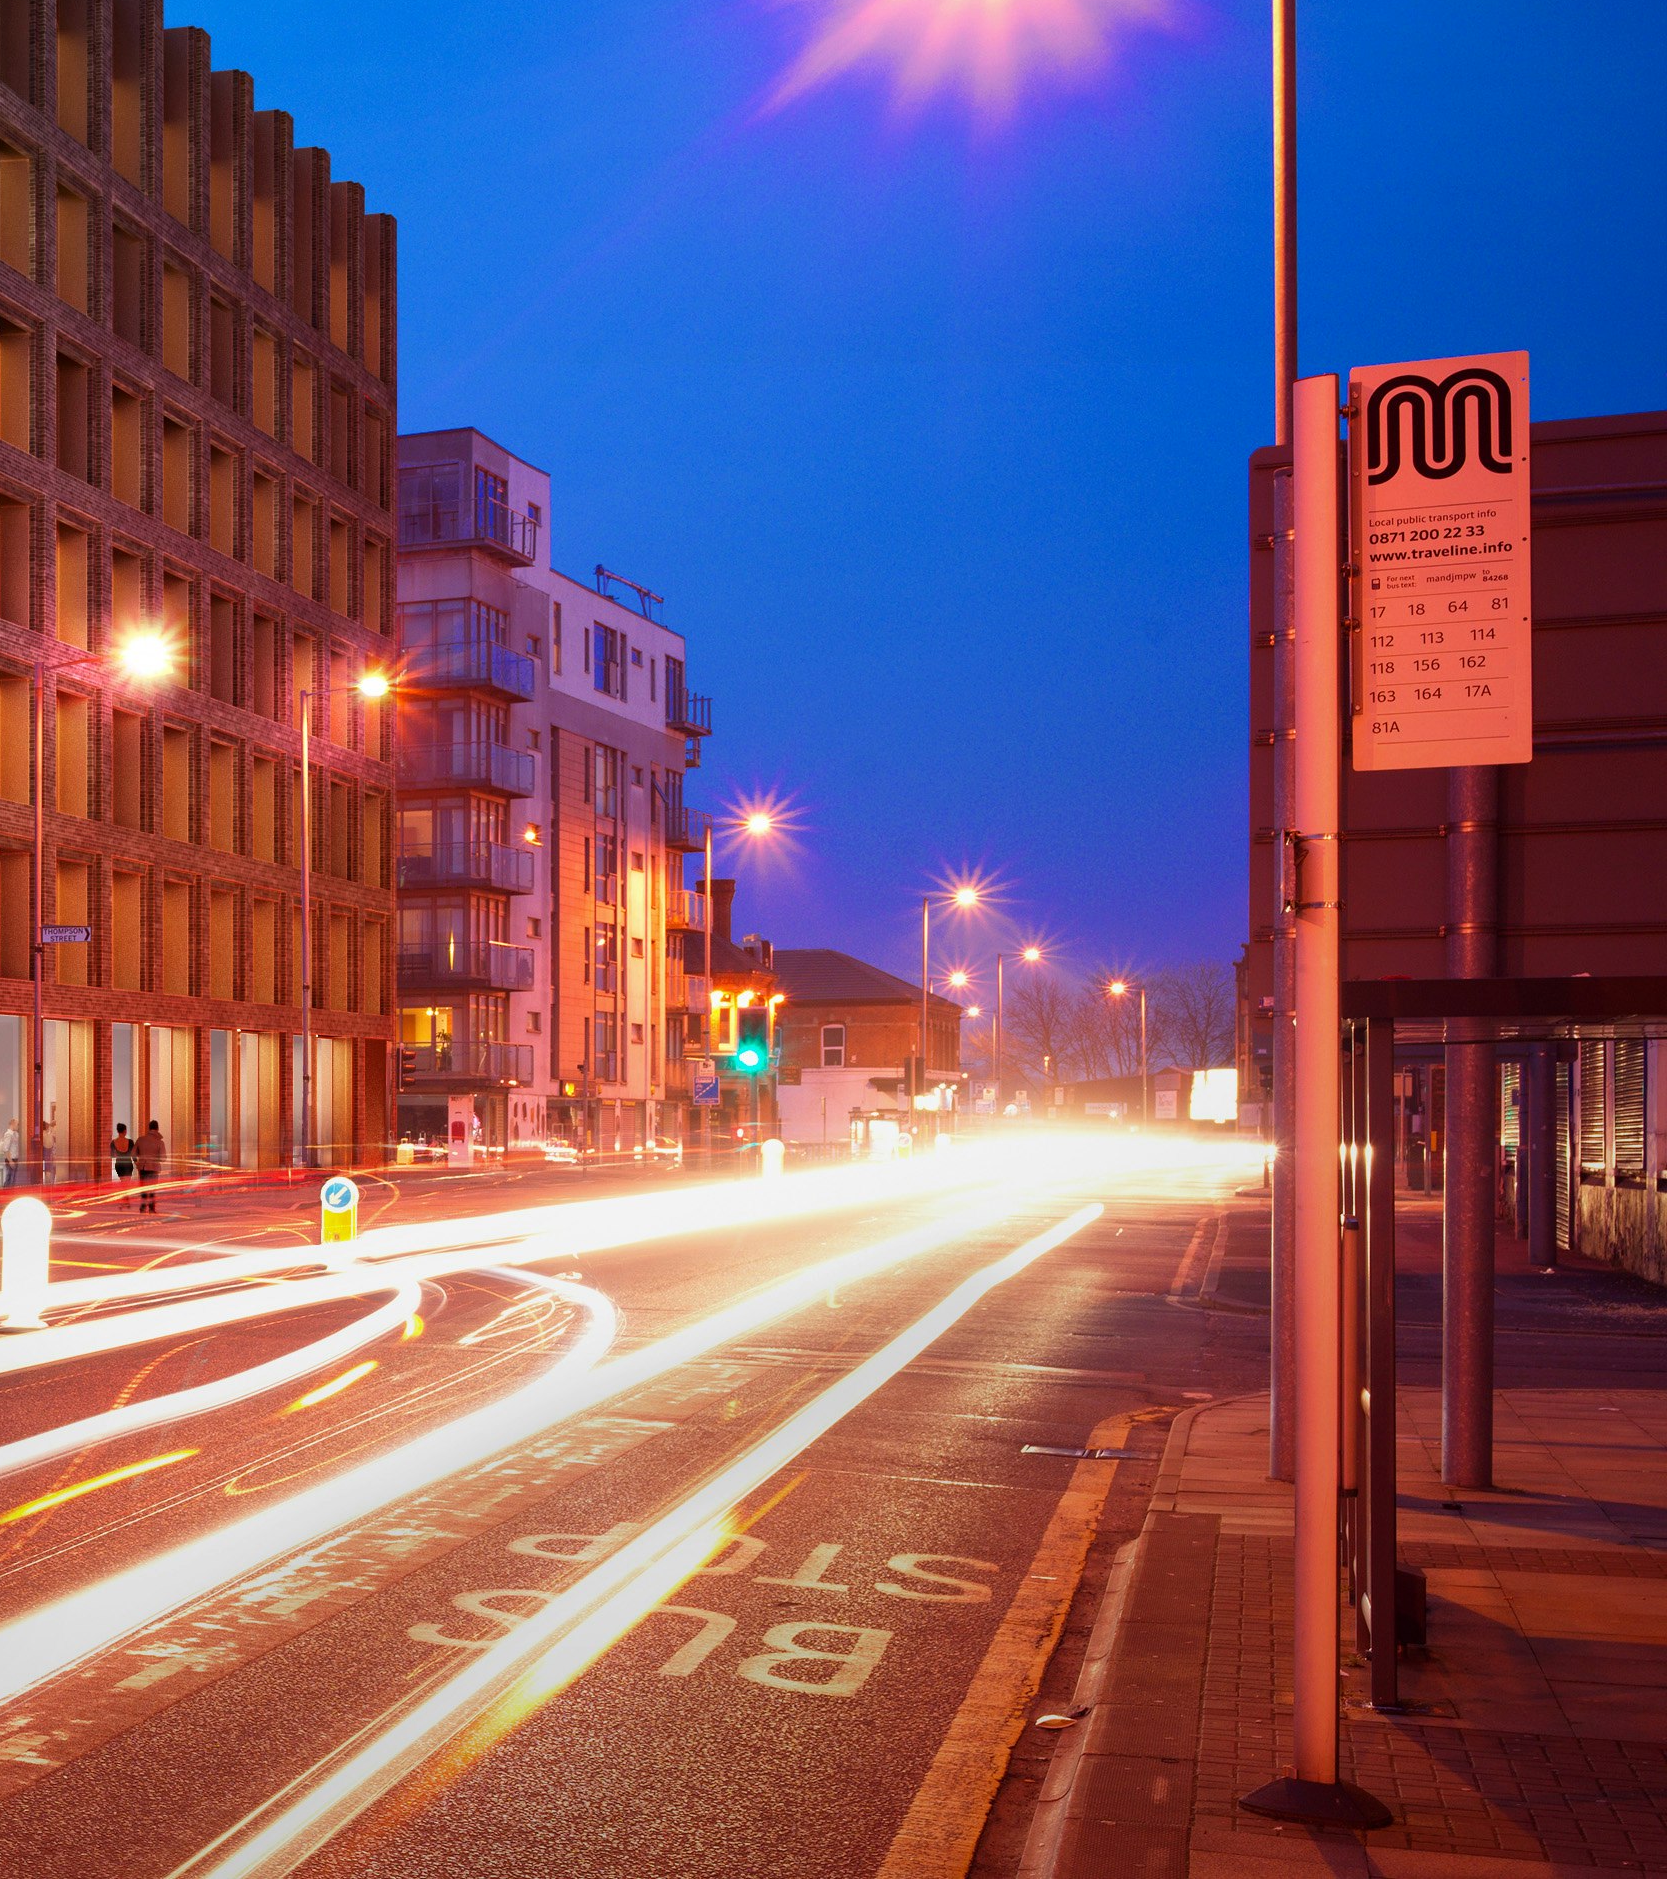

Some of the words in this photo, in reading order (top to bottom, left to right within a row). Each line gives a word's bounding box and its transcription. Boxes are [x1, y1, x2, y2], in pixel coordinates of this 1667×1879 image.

[1369, 518, 1394, 527] Local
[1397, 515, 1426, 526] public
[1429, 511, 1474, 523] transport
[1478, 509, 1496, 518] info
[1369, 531, 1405, 544] 0871
[1410, 529, 1439, 541] 200
[1443, 527, 1462, 539] 22
[1466, 525, 1485, 536] 33
[1370, 541, 1512, 562] www.traveline.info
[1370, 606, 1386, 619] 17
[1408, 603, 1426, 616] 18
[1448, 600, 1469, 613] 64
[1491, 597, 1509, 610] 81
[1370, 634, 1394, 648] 112
[1420, 631, 1444, 645] 113
[1470, 628, 1496, 641] 114
[1369, 661, 1395, 675] 118
[1413, 658, 1440, 672] 156
[1459, 655, 1486, 669] 162
[1369, 689, 1396, 703] 163
[1414, 686, 1442, 700] 164
[1464, 684, 1492, 697] 17A
[1372, 721, 1400, 734] 81A
